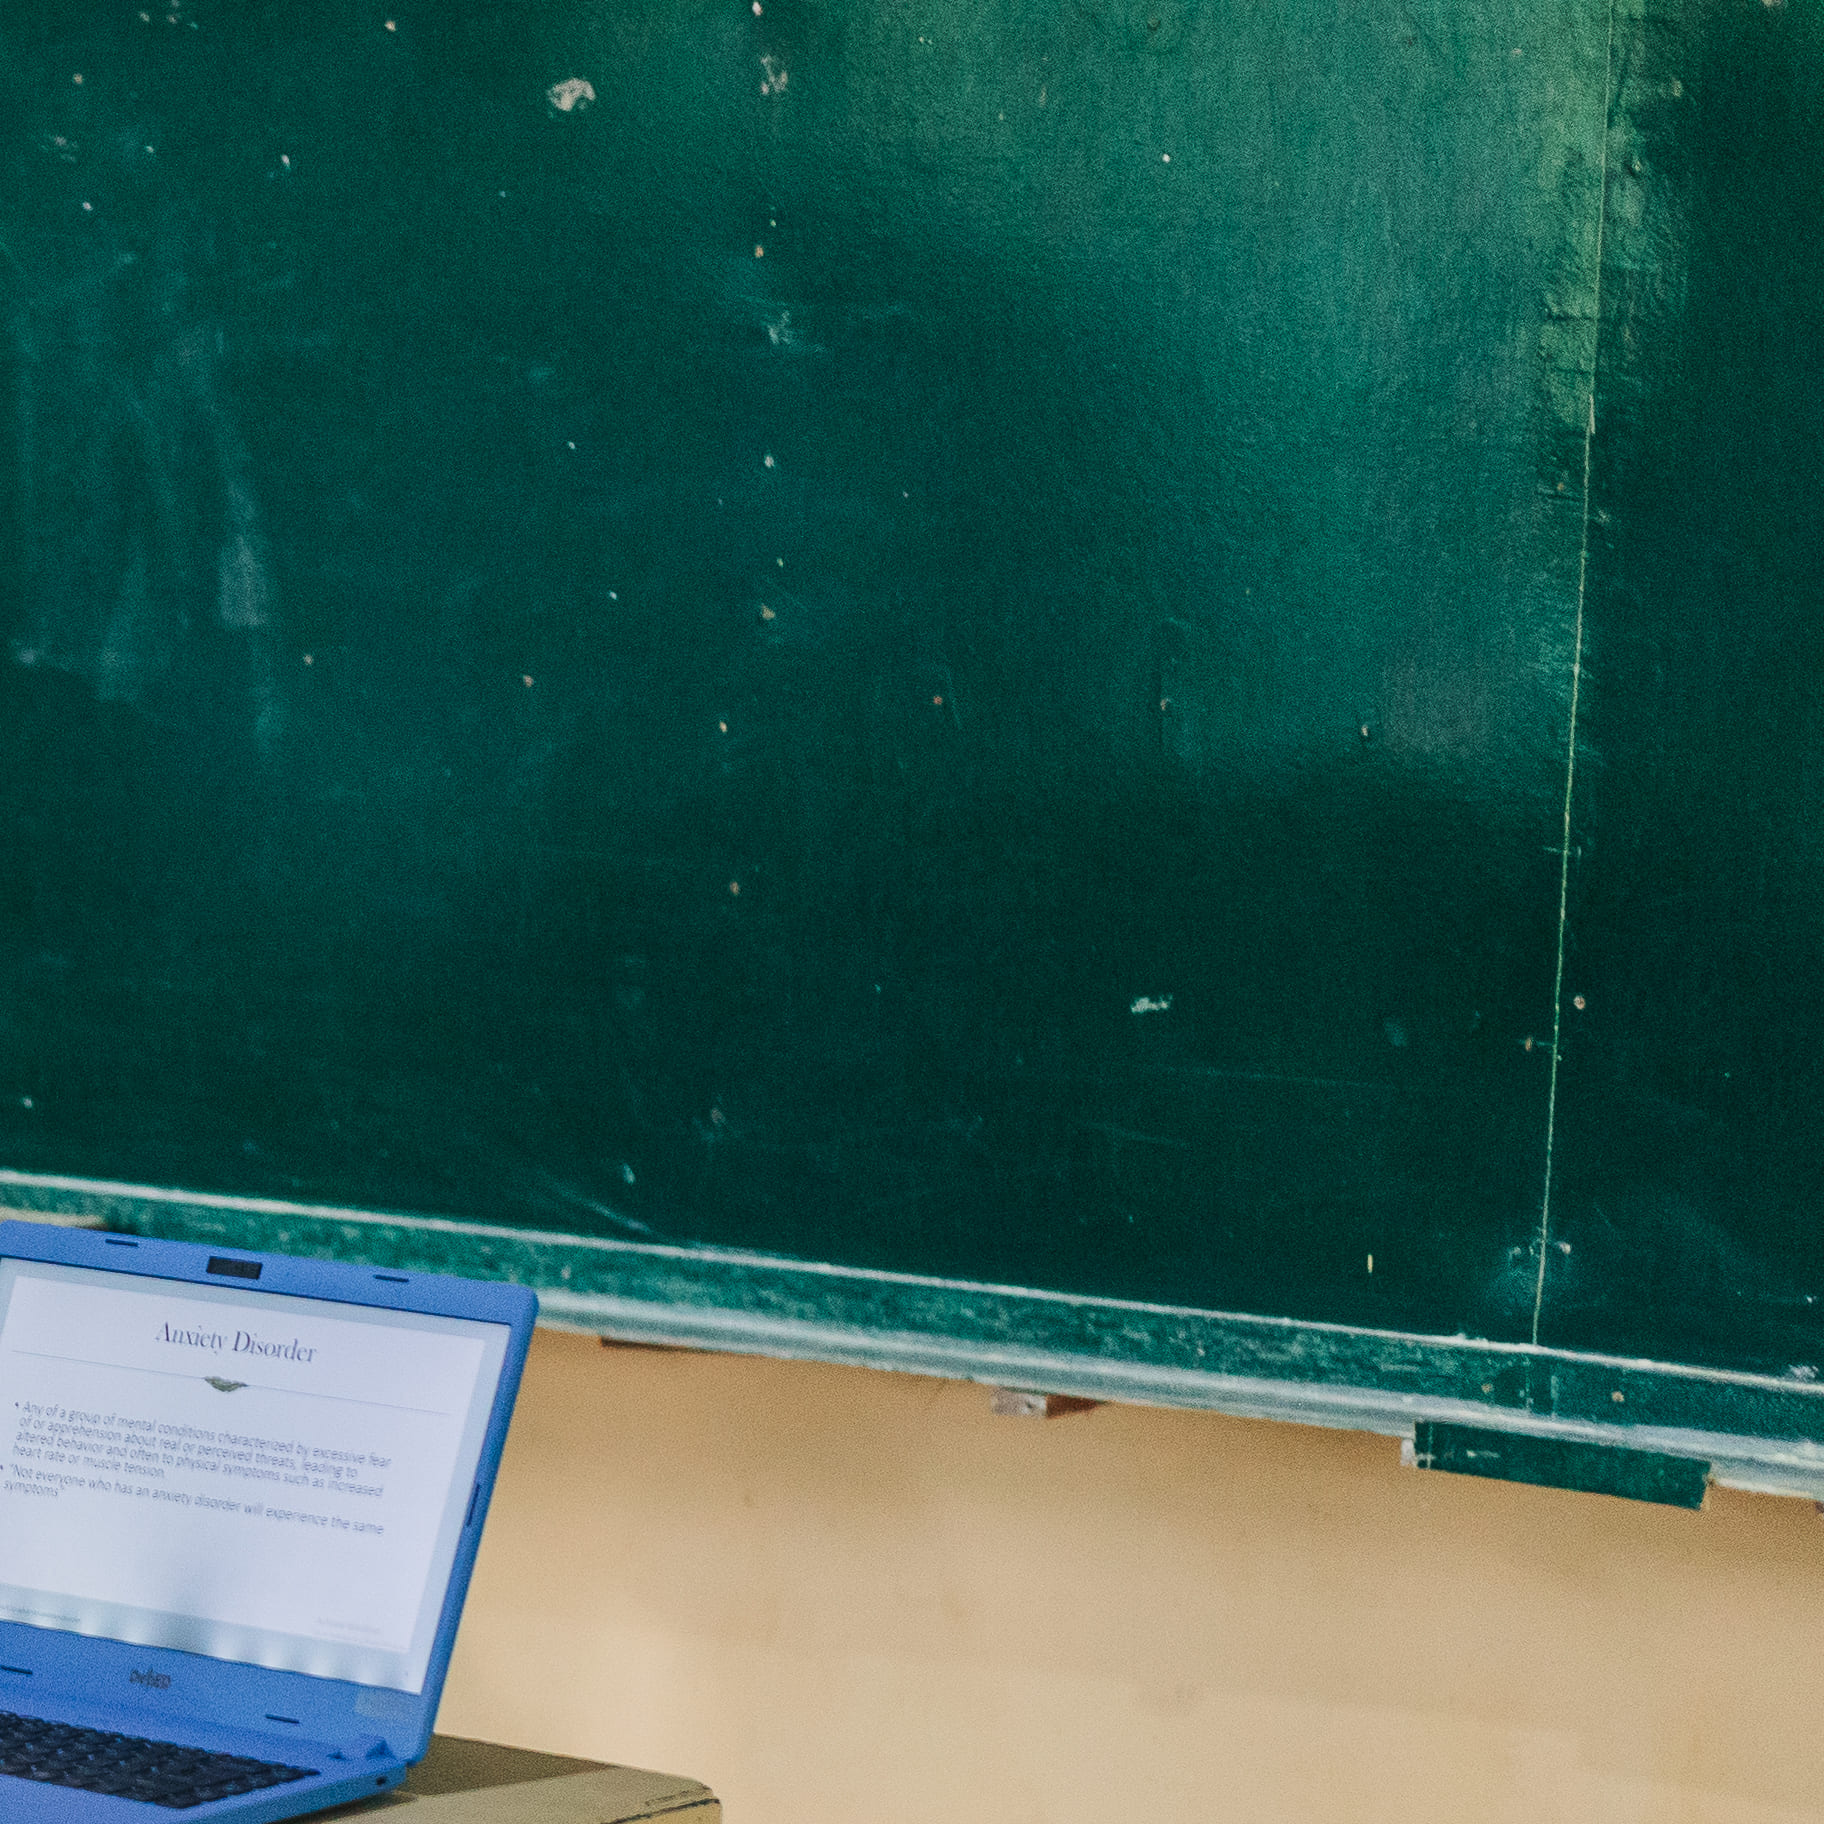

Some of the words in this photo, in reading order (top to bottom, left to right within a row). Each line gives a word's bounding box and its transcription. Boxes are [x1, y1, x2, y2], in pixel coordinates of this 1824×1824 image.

[155, 1321, 227, 1356] Anxiety
[232, 1330, 317, 1363] Disorder
[12, 1441, 42, 1459] heart
[44, 1447, 66, 1463] rate
[67, 1452, 80, 1465] or
[83, 1455, 121, 1471] muscle
[16, 1430, 53, 1446] altered
[56, 1435, 104, 1454] behavior
[106, 1443, 128, 1458] and
[129, 1447, 159, 1463] often
[161, 1451, 174, 1465] to
[175, 1453, 220, 1473] physical
[222, 1462, 280, 1481] symptoms
[282, 1470, 310, 1487] such
[311, 1477, 325, 1489] as
[327, 1478, 384, 1497] increased
[19, 1415, 33, 1427] of
[33, 1418, 45, 1429] or
[47, 1422, 122, 1442] apprehension
[124, 1430, 157, 1447] about
[159, 1436, 181, 1451] real
[182, 1441, 197, 1453] or
[198, 1443, 252, 1463] perceived
[300, 1457, 343, 1479] leading
[346, 1465, 358, 1478] to
[23, 1401, 44, 1417] Any
[45, 1404, 59, 1417] of
[68, 1409, 101, 1425] group
[103, 1412, 117, 1426] of
[117, 1417, 157, 1432] mental
[157, 1423, 215, 1441] conditions
[218, 1431, 294, 1454] characterized
[296, 1442, 309, 1458] by
[312, 1446, 366, 1464] excessive
[369, 1452, 392, 1468] fear
[35, 1469, 86, 1489] everyone
[89, 1477, 112, 1491] who
[114, 1481, 133, 1495] has
[135, 1485, 150, 1497] an
[152, 1487, 193, 1506] anxiety
[194, 1493, 241, 1513] disorder
[244, 1501, 265, 1516] will
[265, 1506, 329, 1527] experience
[331, 1515, 350, 1530] the
[352, 1520, 385, 1535] same
